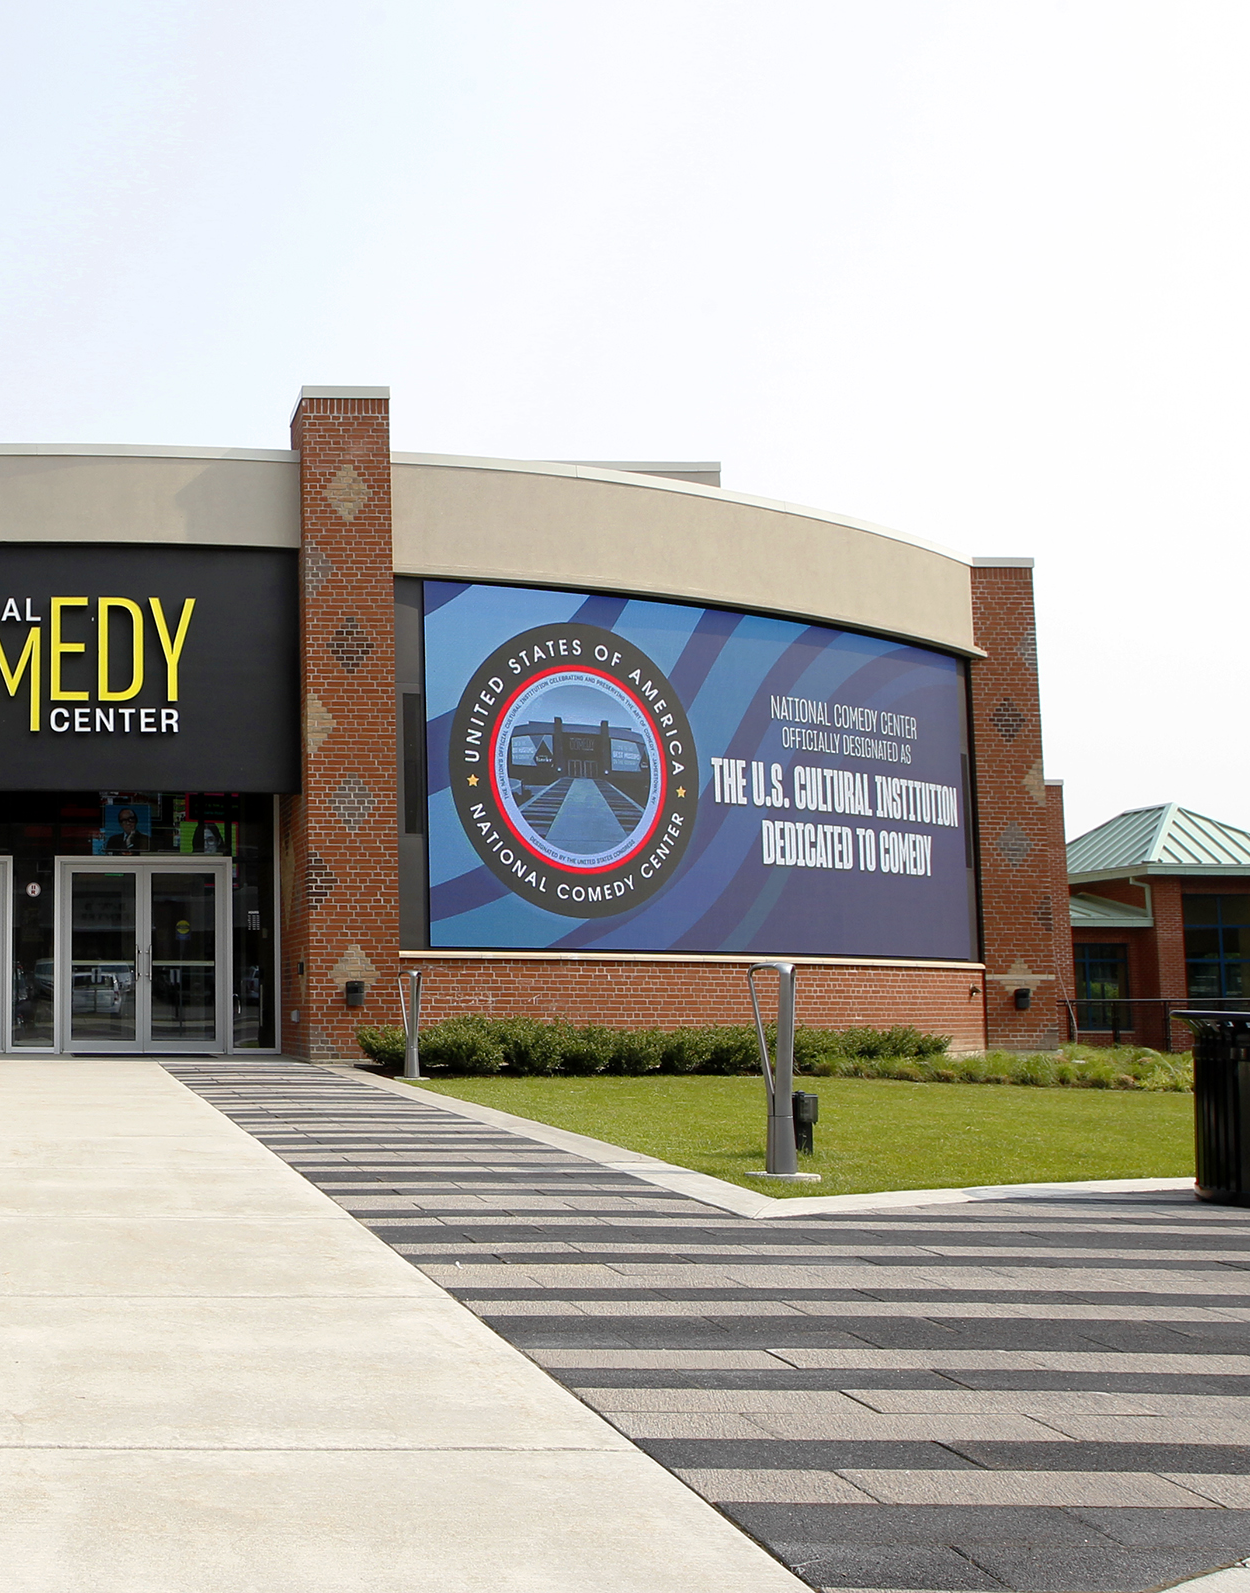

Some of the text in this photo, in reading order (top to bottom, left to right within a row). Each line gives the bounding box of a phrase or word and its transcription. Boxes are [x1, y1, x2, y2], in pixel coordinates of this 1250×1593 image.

[50, 707, 179, 733] CENTER
[464, 639, 685, 775] UNITED STATES OF AMERICA
[505, 703, 521, 728] CULTURAL
[520, 681, 549, 705] INSTITUTION
[770, 694, 918, 740] NATIONAL COMEDY CENTER
[782, 726, 912, 765] OFFICIALLY DESIGNATED AS
[710, 757, 959, 828] THE U.S. CULTURAL INSTITUTION
[470, 803, 685, 902] NATIONAL COMEDY CENTER
[762, 819, 932, 877] DEDICATED TO COMEDY
